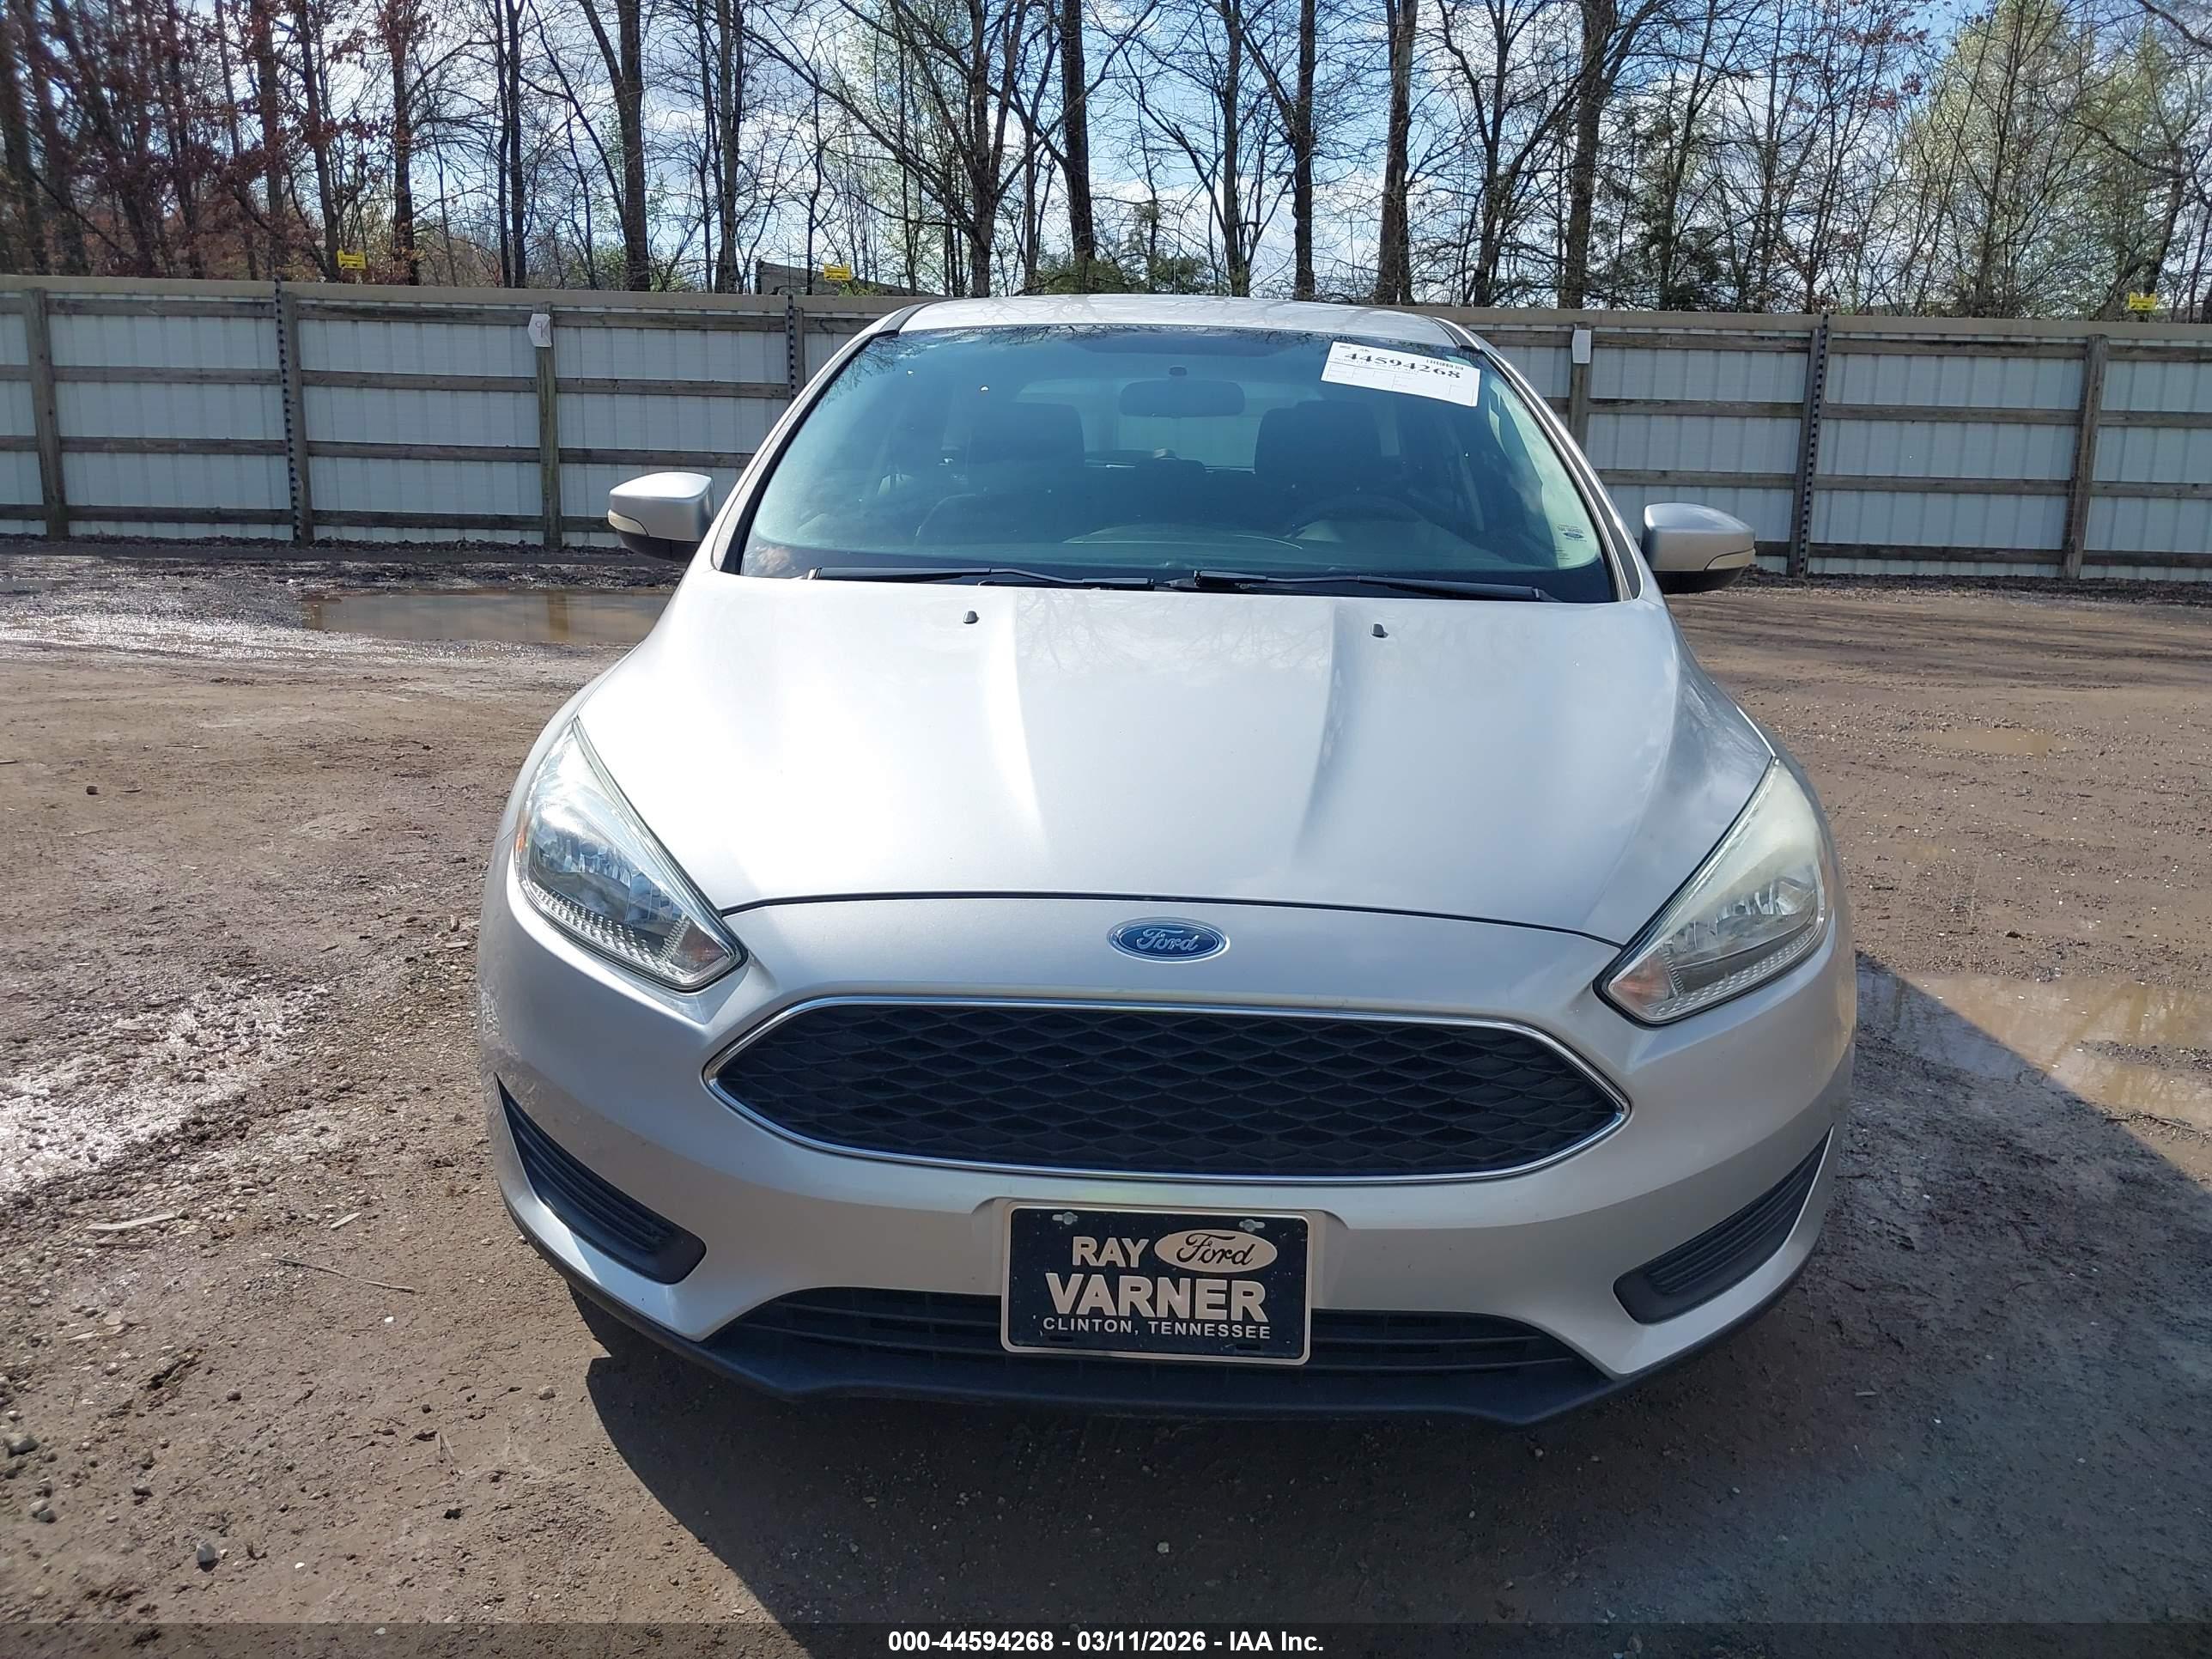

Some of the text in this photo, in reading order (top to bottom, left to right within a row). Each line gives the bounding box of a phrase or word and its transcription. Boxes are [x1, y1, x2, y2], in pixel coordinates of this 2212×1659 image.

[1345, 353, 1461, 379] 44594268
[1136, 927, 1200, 951] Ford
[1073, 1232, 1256, 1267] RAY Ford
[1045, 1273, 1268, 1322] VARNER
[1042, 1316, 1271, 1340] CLINTON, TENNESSEE
